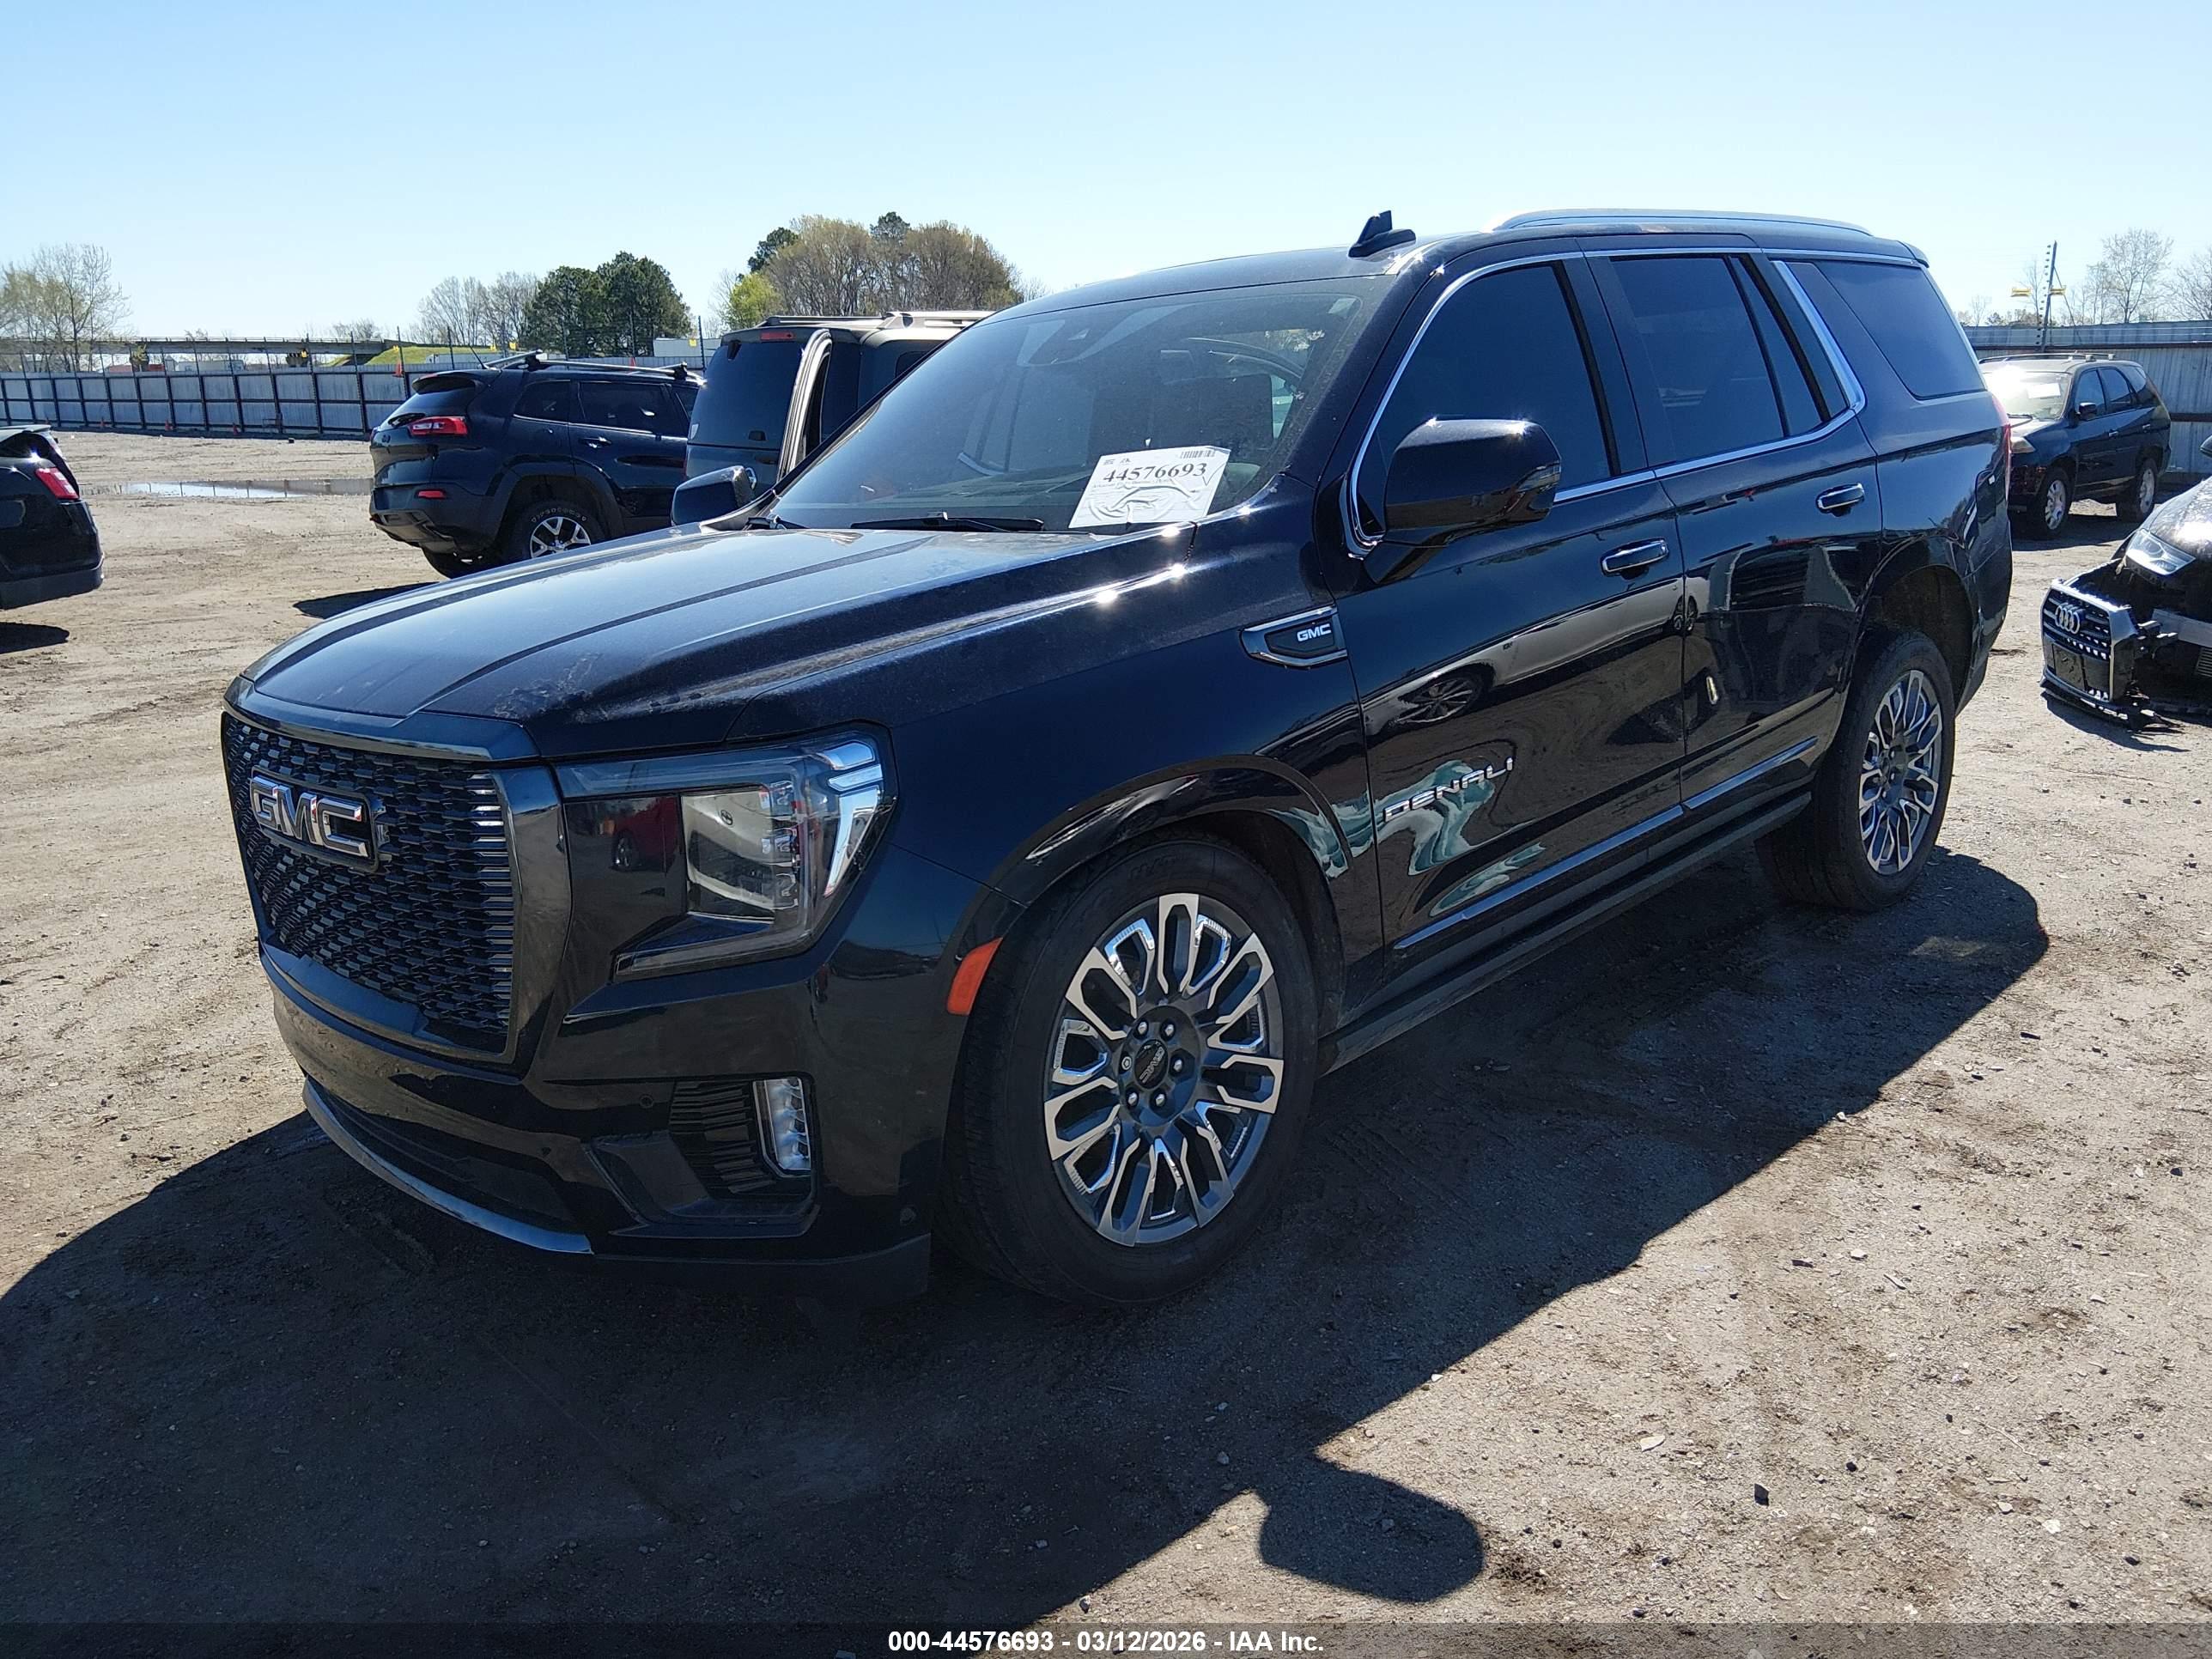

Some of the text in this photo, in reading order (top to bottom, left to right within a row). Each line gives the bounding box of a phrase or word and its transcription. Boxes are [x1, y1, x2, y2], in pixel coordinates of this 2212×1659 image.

[1103, 462, 1207, 483] 44576693
[1297, 623, 1332, 641] GMC
[250, 775, 369, 858] GMC
[1139, 1046, 1165, 1084] GMC
